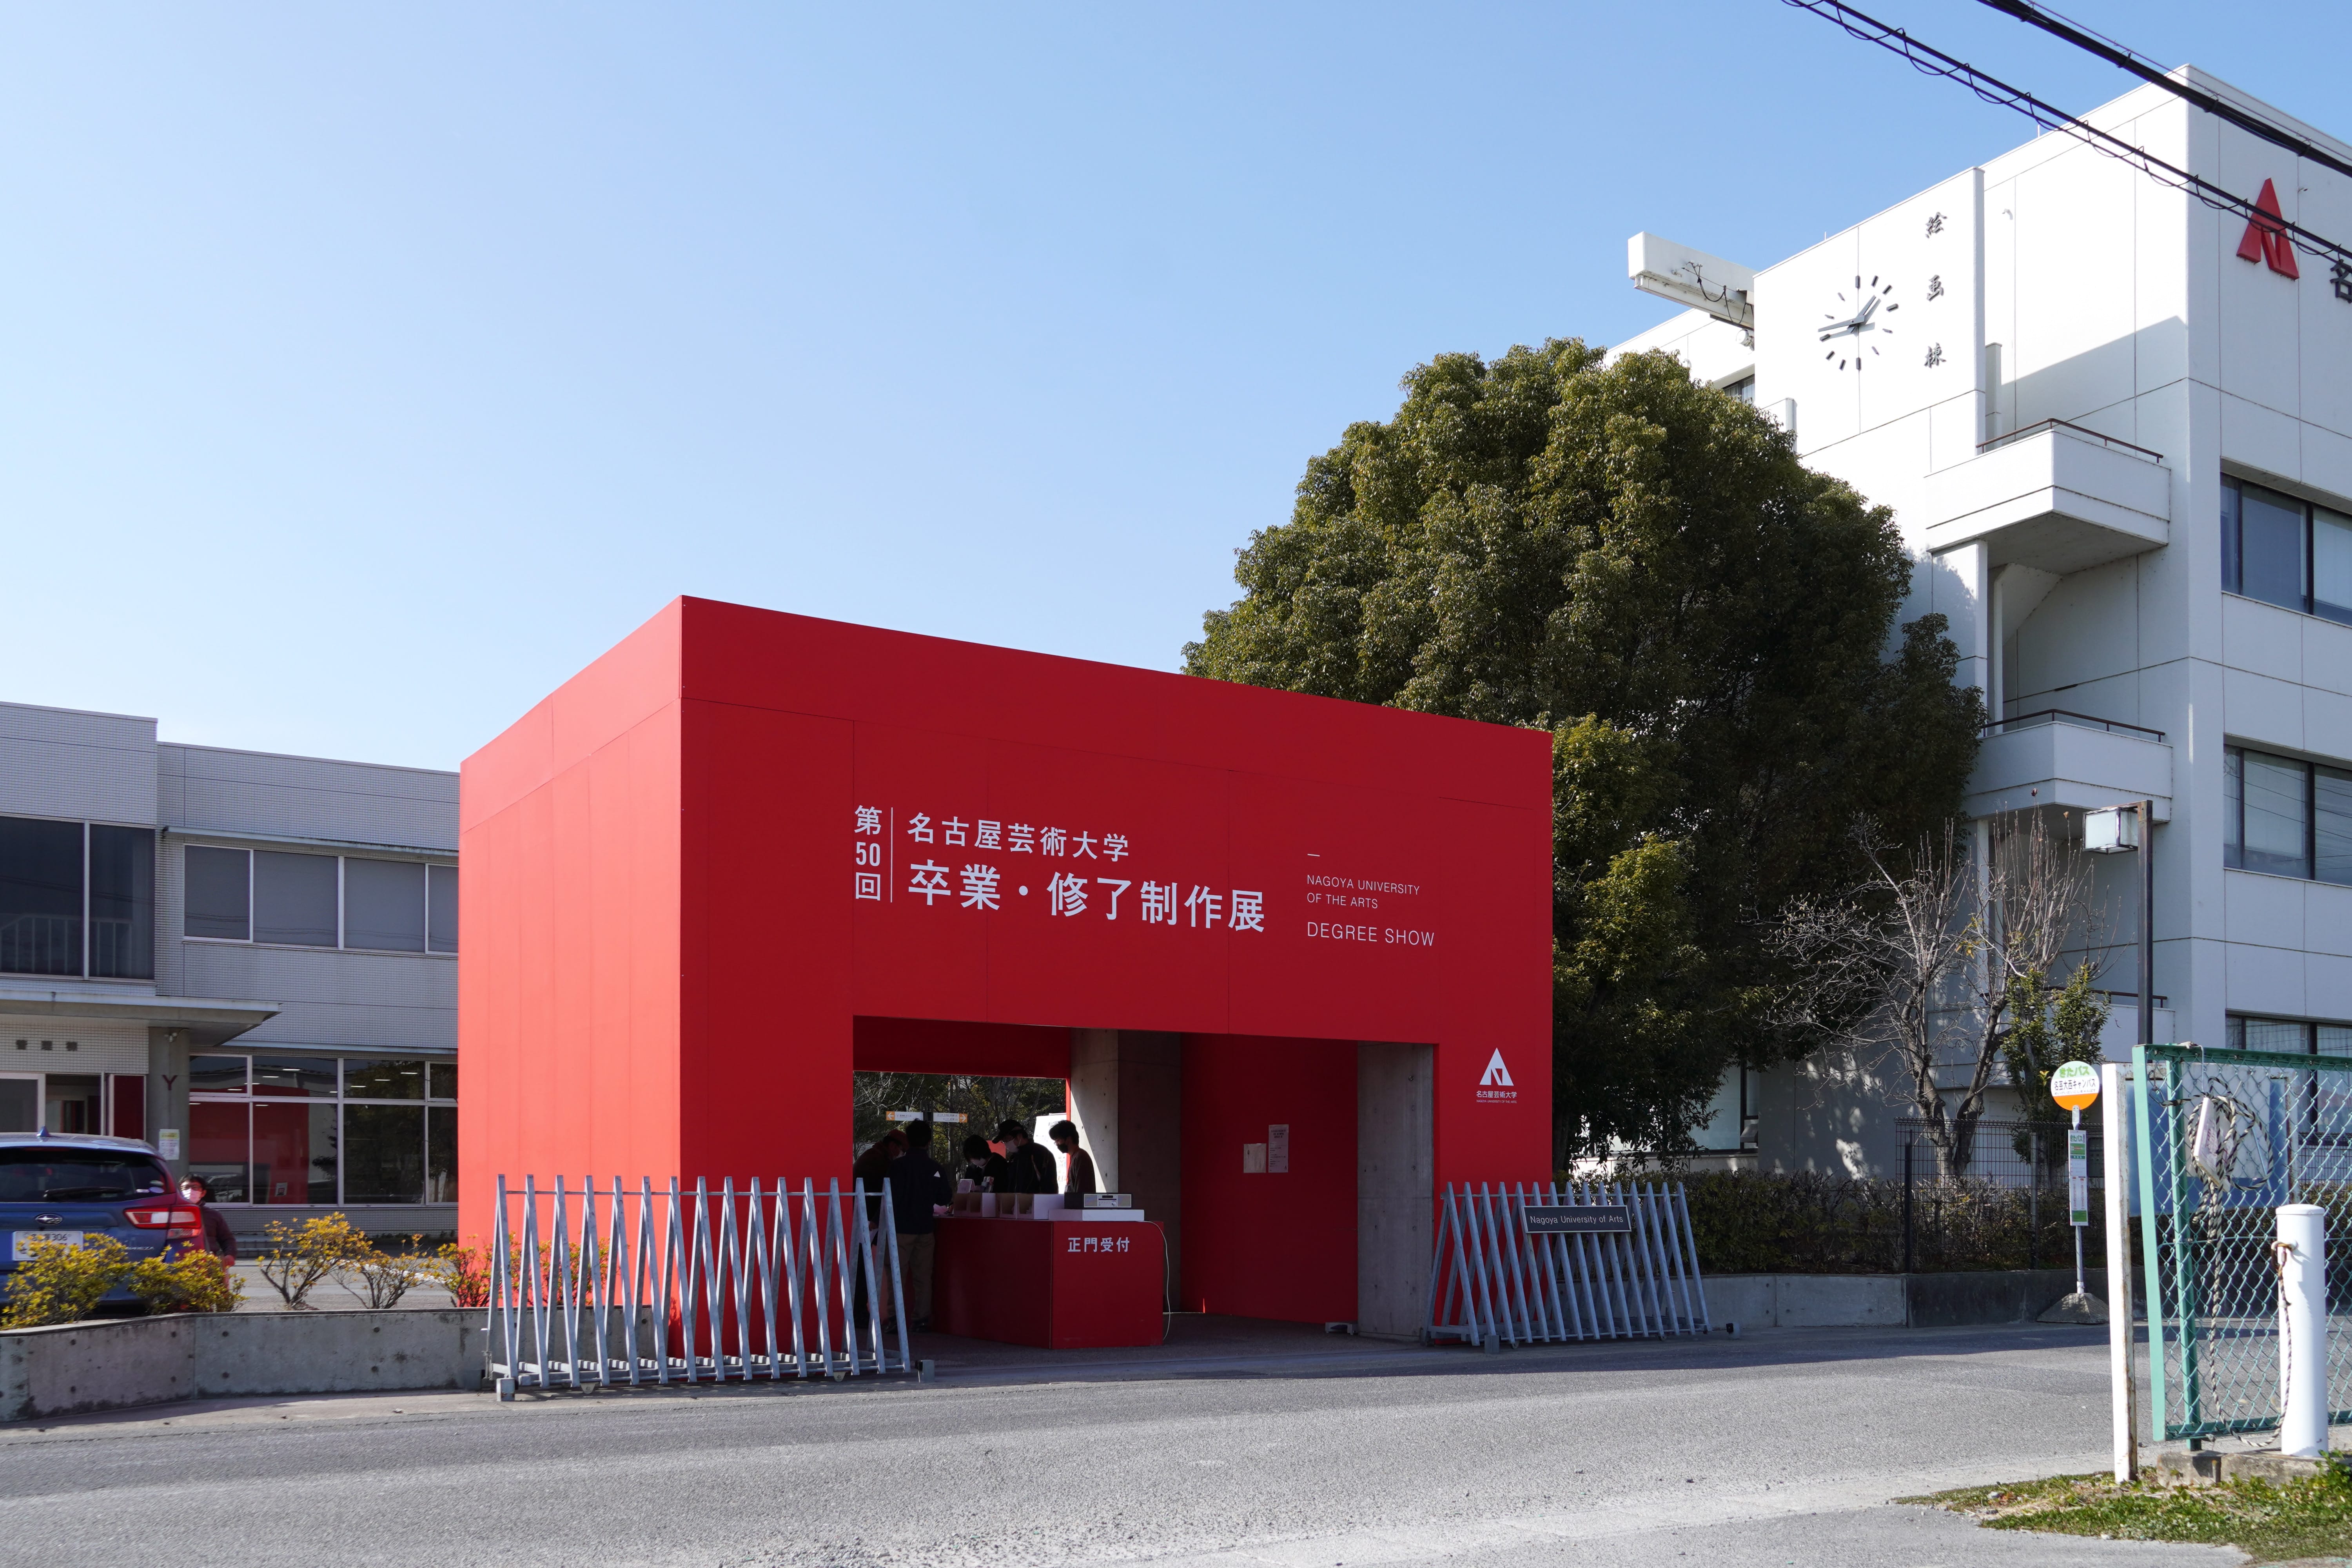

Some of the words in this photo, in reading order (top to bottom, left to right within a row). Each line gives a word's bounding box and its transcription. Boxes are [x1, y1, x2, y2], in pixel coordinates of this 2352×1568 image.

[907, 812, 1129, 862] 名古屋芸術大学
[855, 805, 882, 901] 第50回
[1307, 875, 1354, 889] NAGOYA
[1358, 880, 1420, 895] UNIVERSITY
[908, 859, 1264, 932] 卒業・修了制作展
[1307, 893, 1322, 903] OF
[1325, 894, 1347, 906] THE
[1350, 897, 1378, 909] ARTS
[1308, 922, 1377, 942] DEGREE
[1385, 928, 1434, 946] SHOW
[2060, 1065, 2089, 1078] きたバス
[162, 1075, 178, 1090] Y
[1476, 1090, 1517, 1098] 名古屋芸術大学
[1530, 1216, 1558, 1225] Nagoya
[1561, 1215, 1597, 1224] University
[1599, 1215, 1606, 1223] of
[1067, 1237, 1130, 1252] 正門受付
